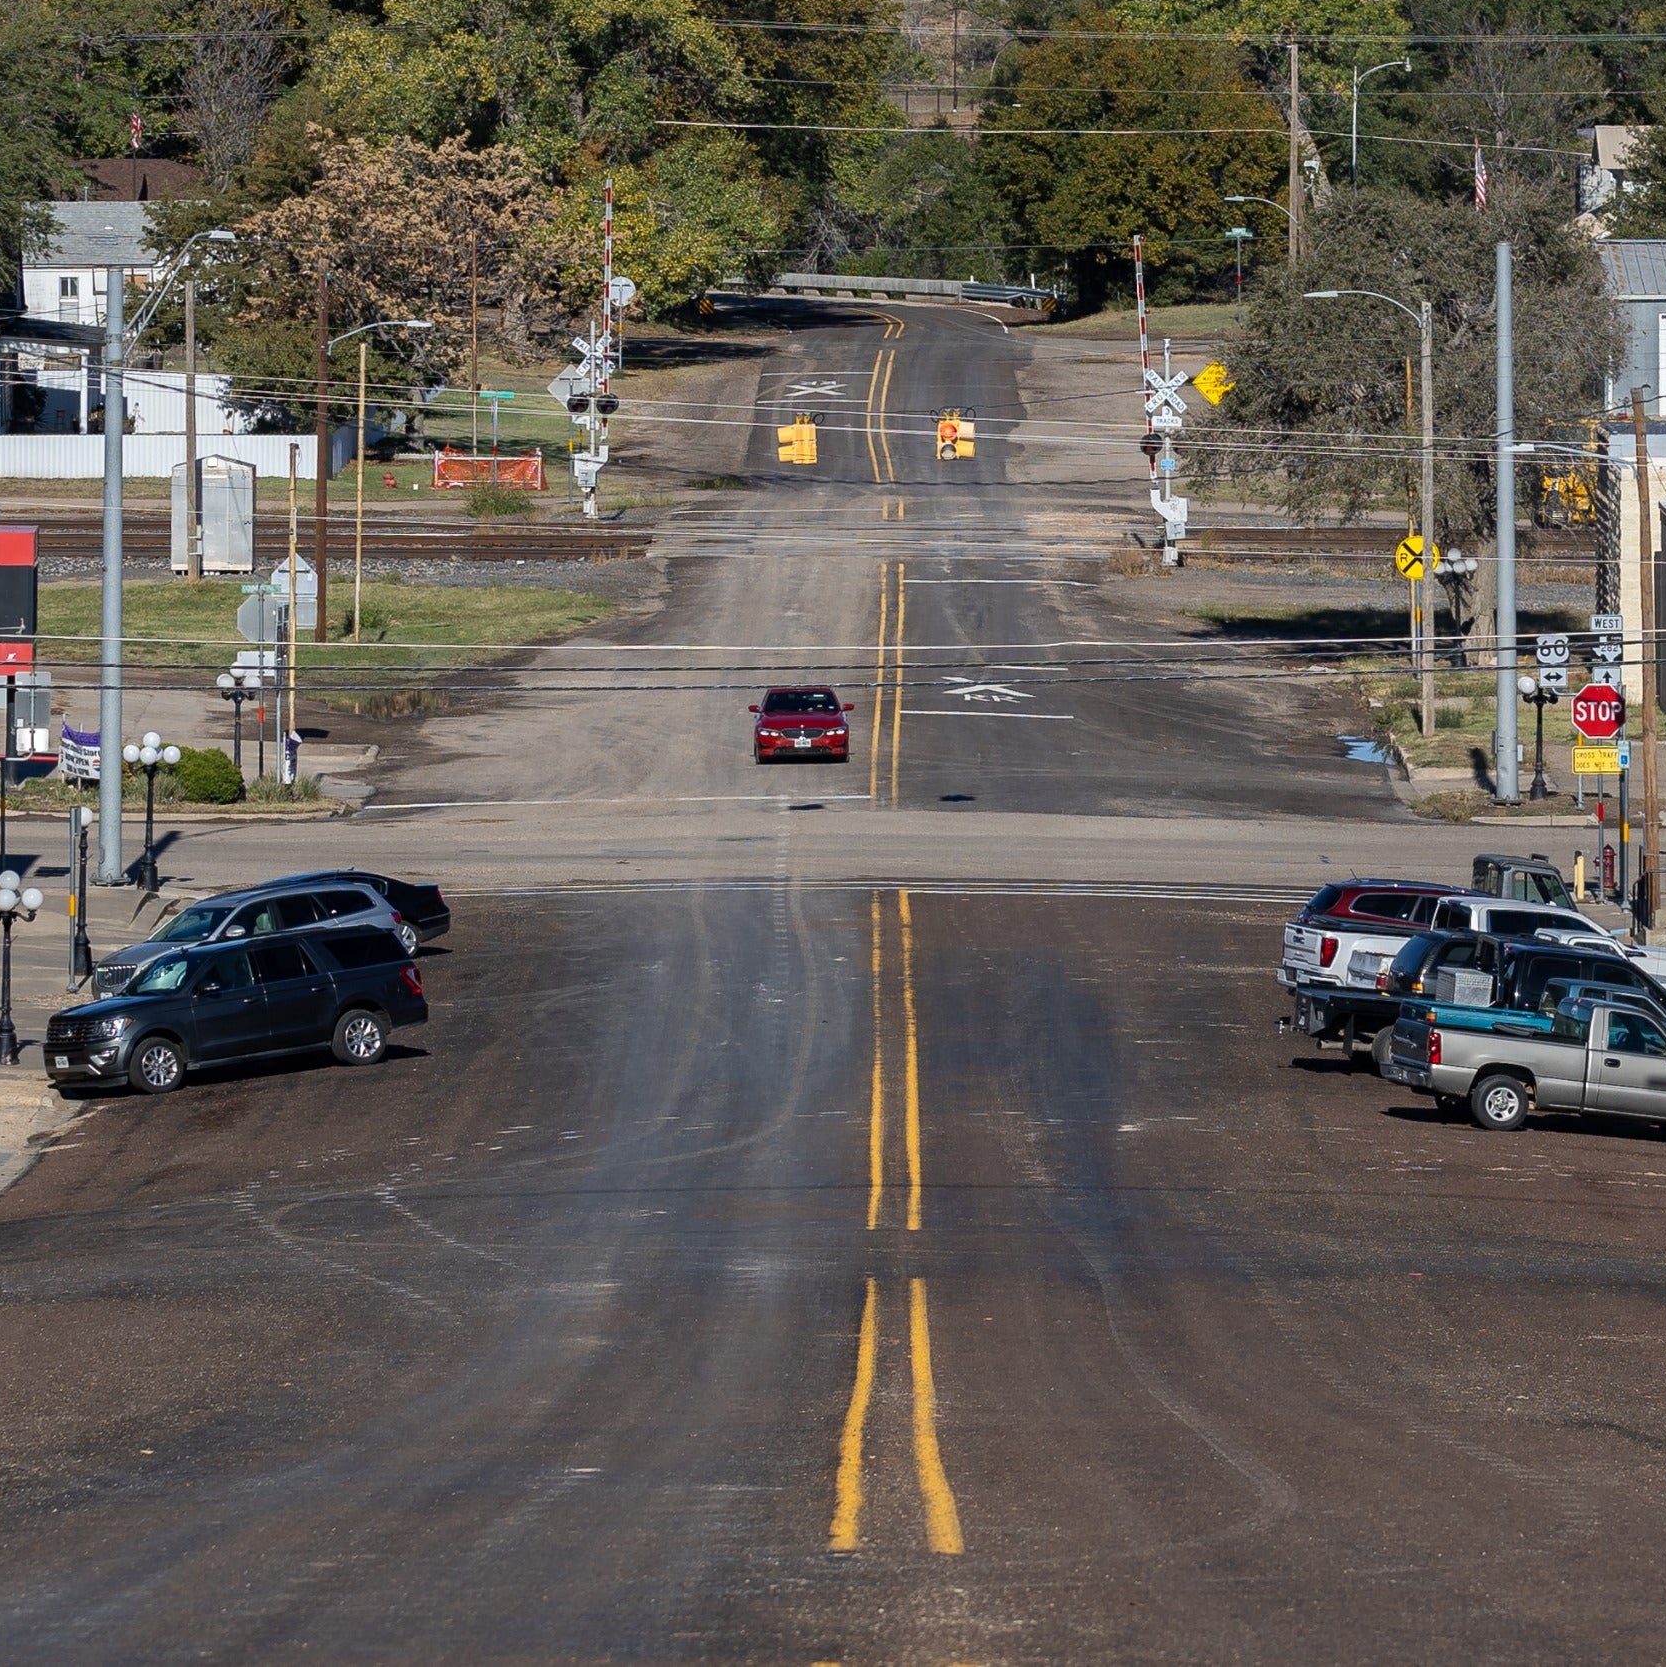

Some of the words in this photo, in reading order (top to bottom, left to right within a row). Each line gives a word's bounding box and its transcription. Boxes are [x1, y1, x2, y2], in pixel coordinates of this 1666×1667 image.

[1400, 552, 1409, 563] R
[1594, 617, 1620, 629] WEST
[1540, 639, 1566, 657] 60
[1576, 700, 1622, 722] STOP
